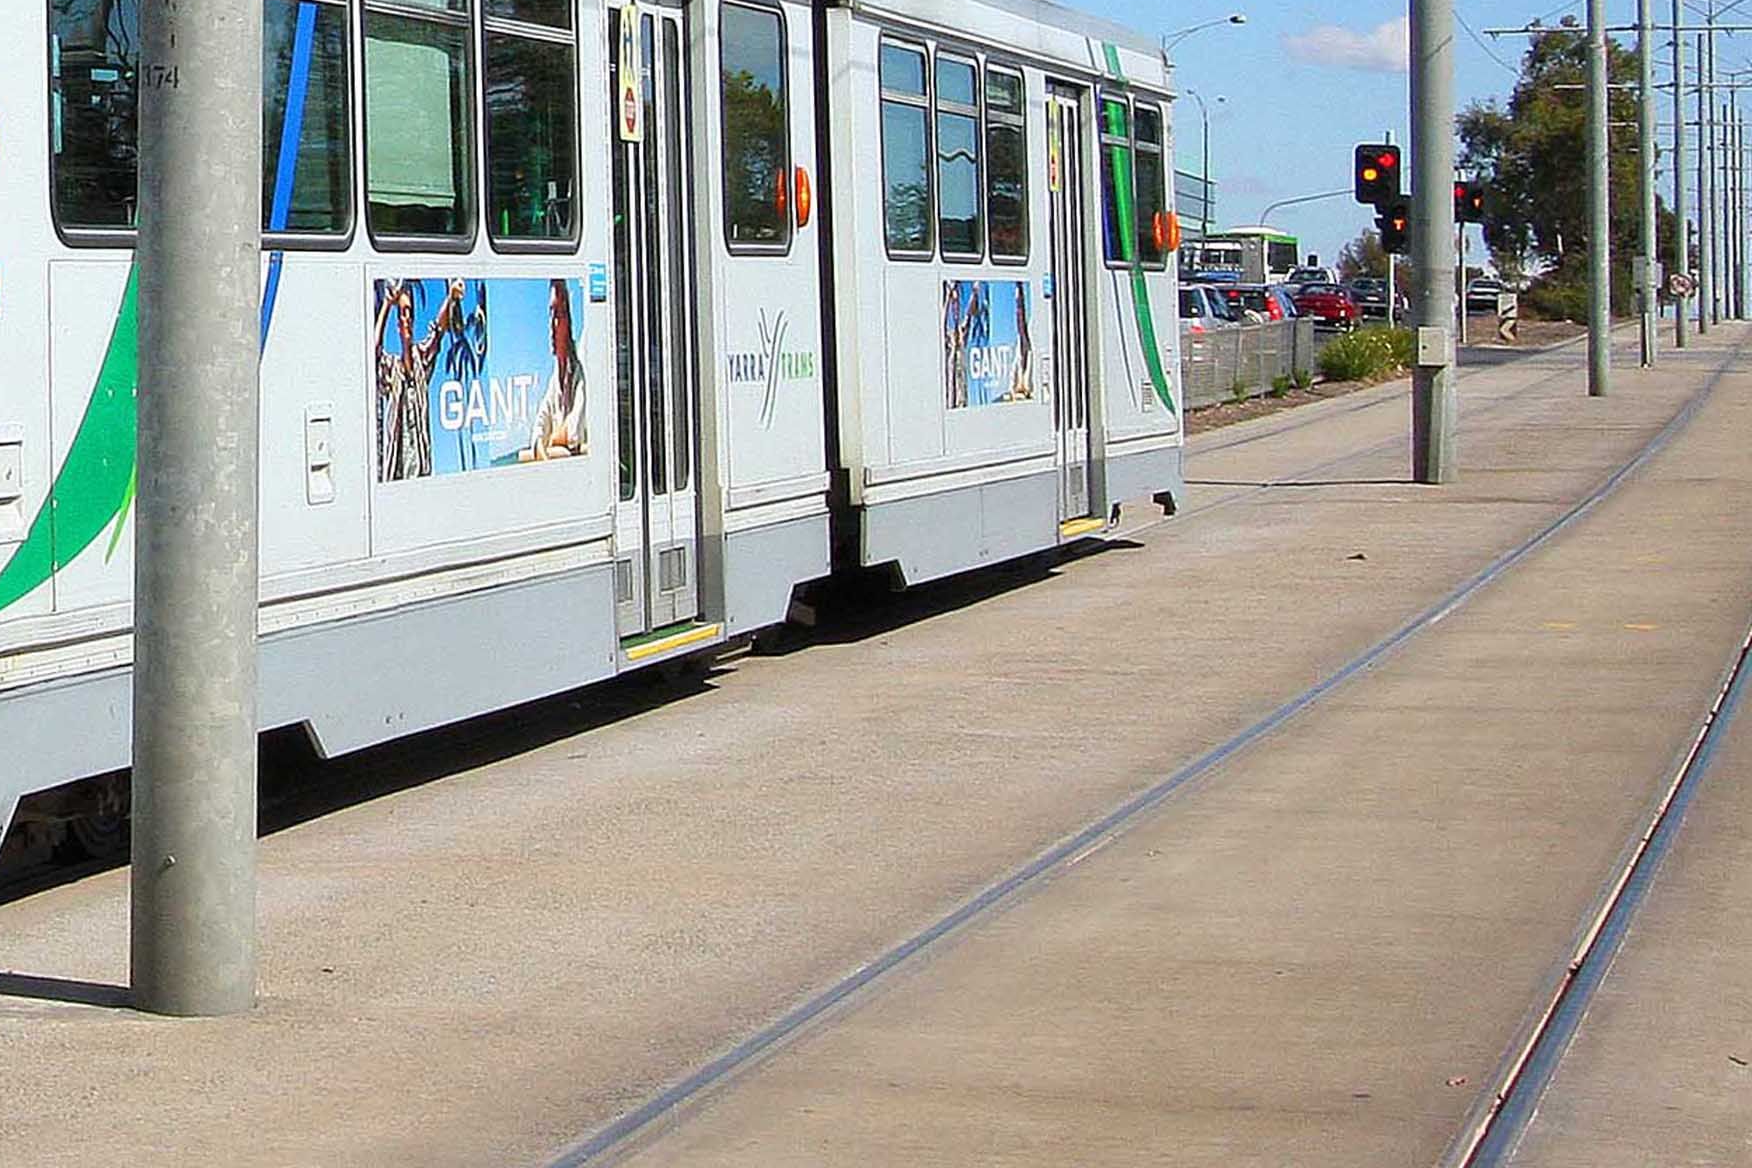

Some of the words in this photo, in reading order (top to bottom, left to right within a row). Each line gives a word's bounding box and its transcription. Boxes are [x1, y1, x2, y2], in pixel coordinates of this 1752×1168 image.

[728, 353, 766, 382] YARRA
[781, 351, 814, 381] TRAMS
[969, 345, 1011, 380] GANT
[439, 375, 532, 431] GANT
